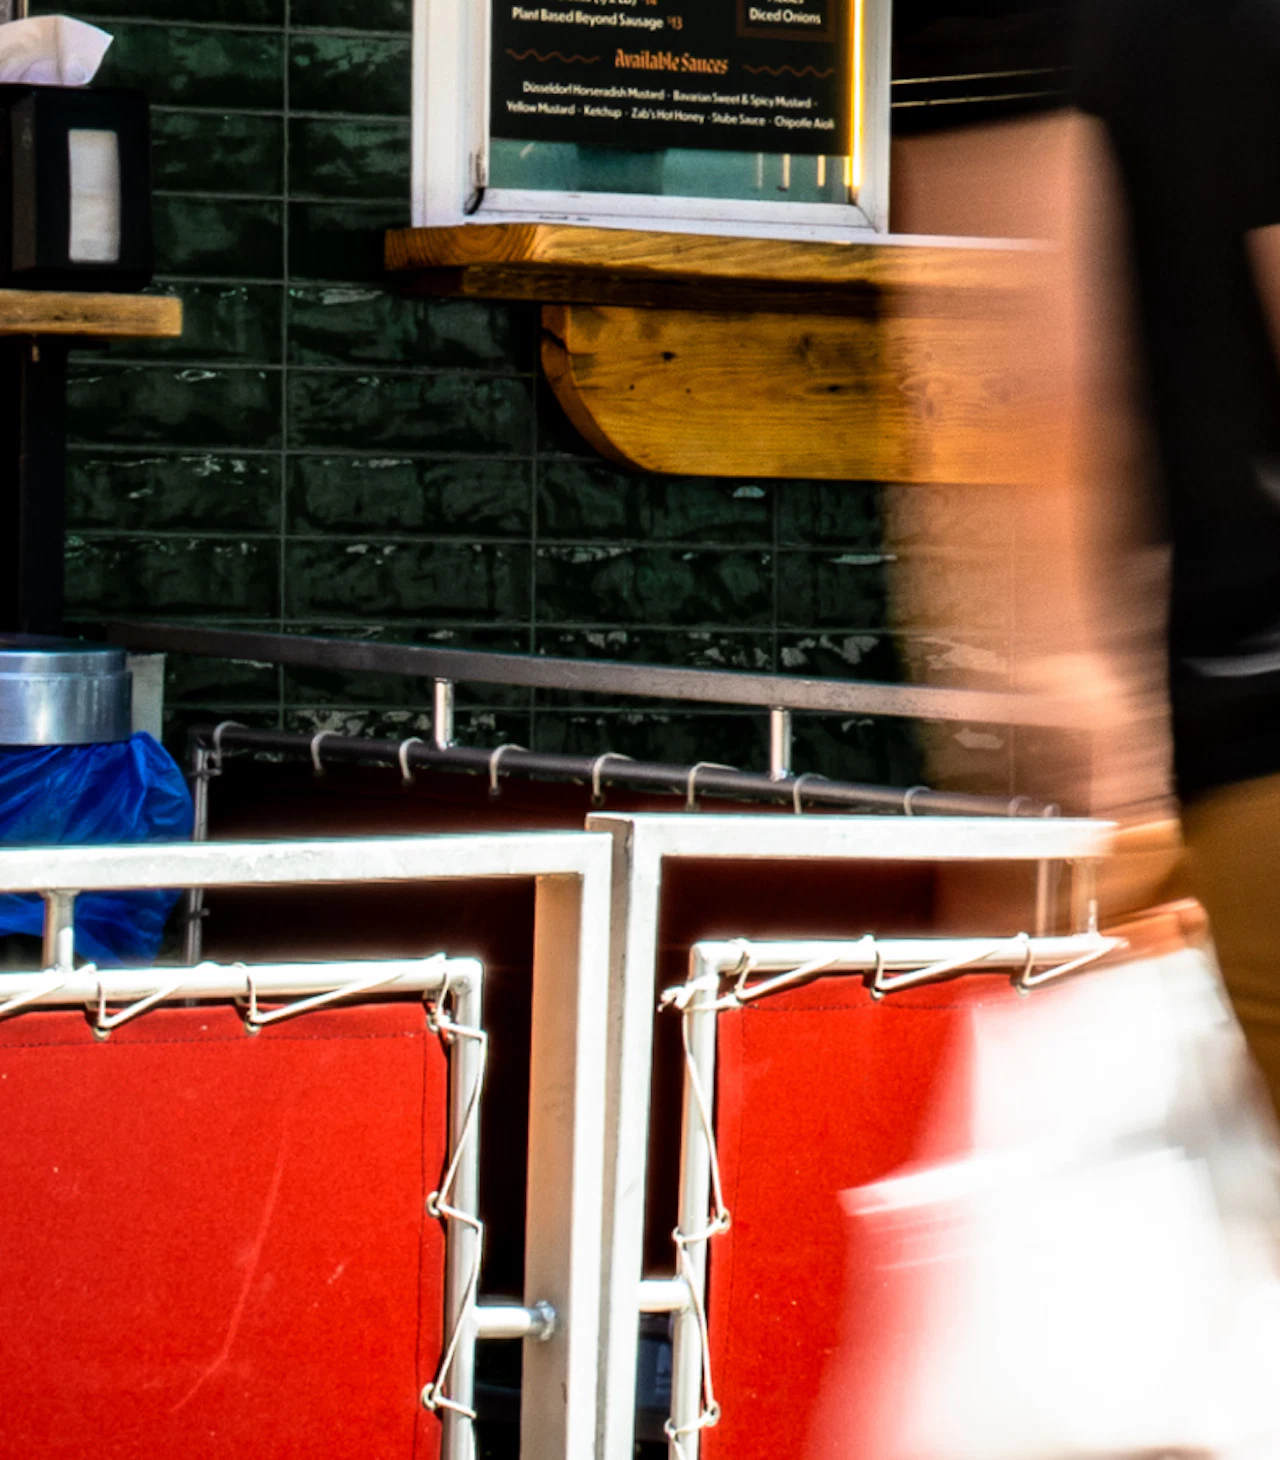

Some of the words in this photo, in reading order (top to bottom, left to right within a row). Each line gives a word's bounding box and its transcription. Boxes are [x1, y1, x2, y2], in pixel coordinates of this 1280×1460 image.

[512, 6, 539, 20] Plant
[541, 9, 574, 23] Based
[575, 11, 617, 27] Beyond
[619, 13, 664, 31] Sausage
[749, 7, 781, 22] Diced
[783, 9, 821, 25] Onions
[615, 47, 679, 71] Available
[681, 52, 729, 75] Sauces
[506, 100, 537, 113] Yellow
[538, 102, 576, 115] Mustard
[584, 104, 622, 119] Ketchup
[675, 111, 704, 124] Honey
[739, 114, 765, 126] Sauce
[750, 94, 774, 108] Spicy
